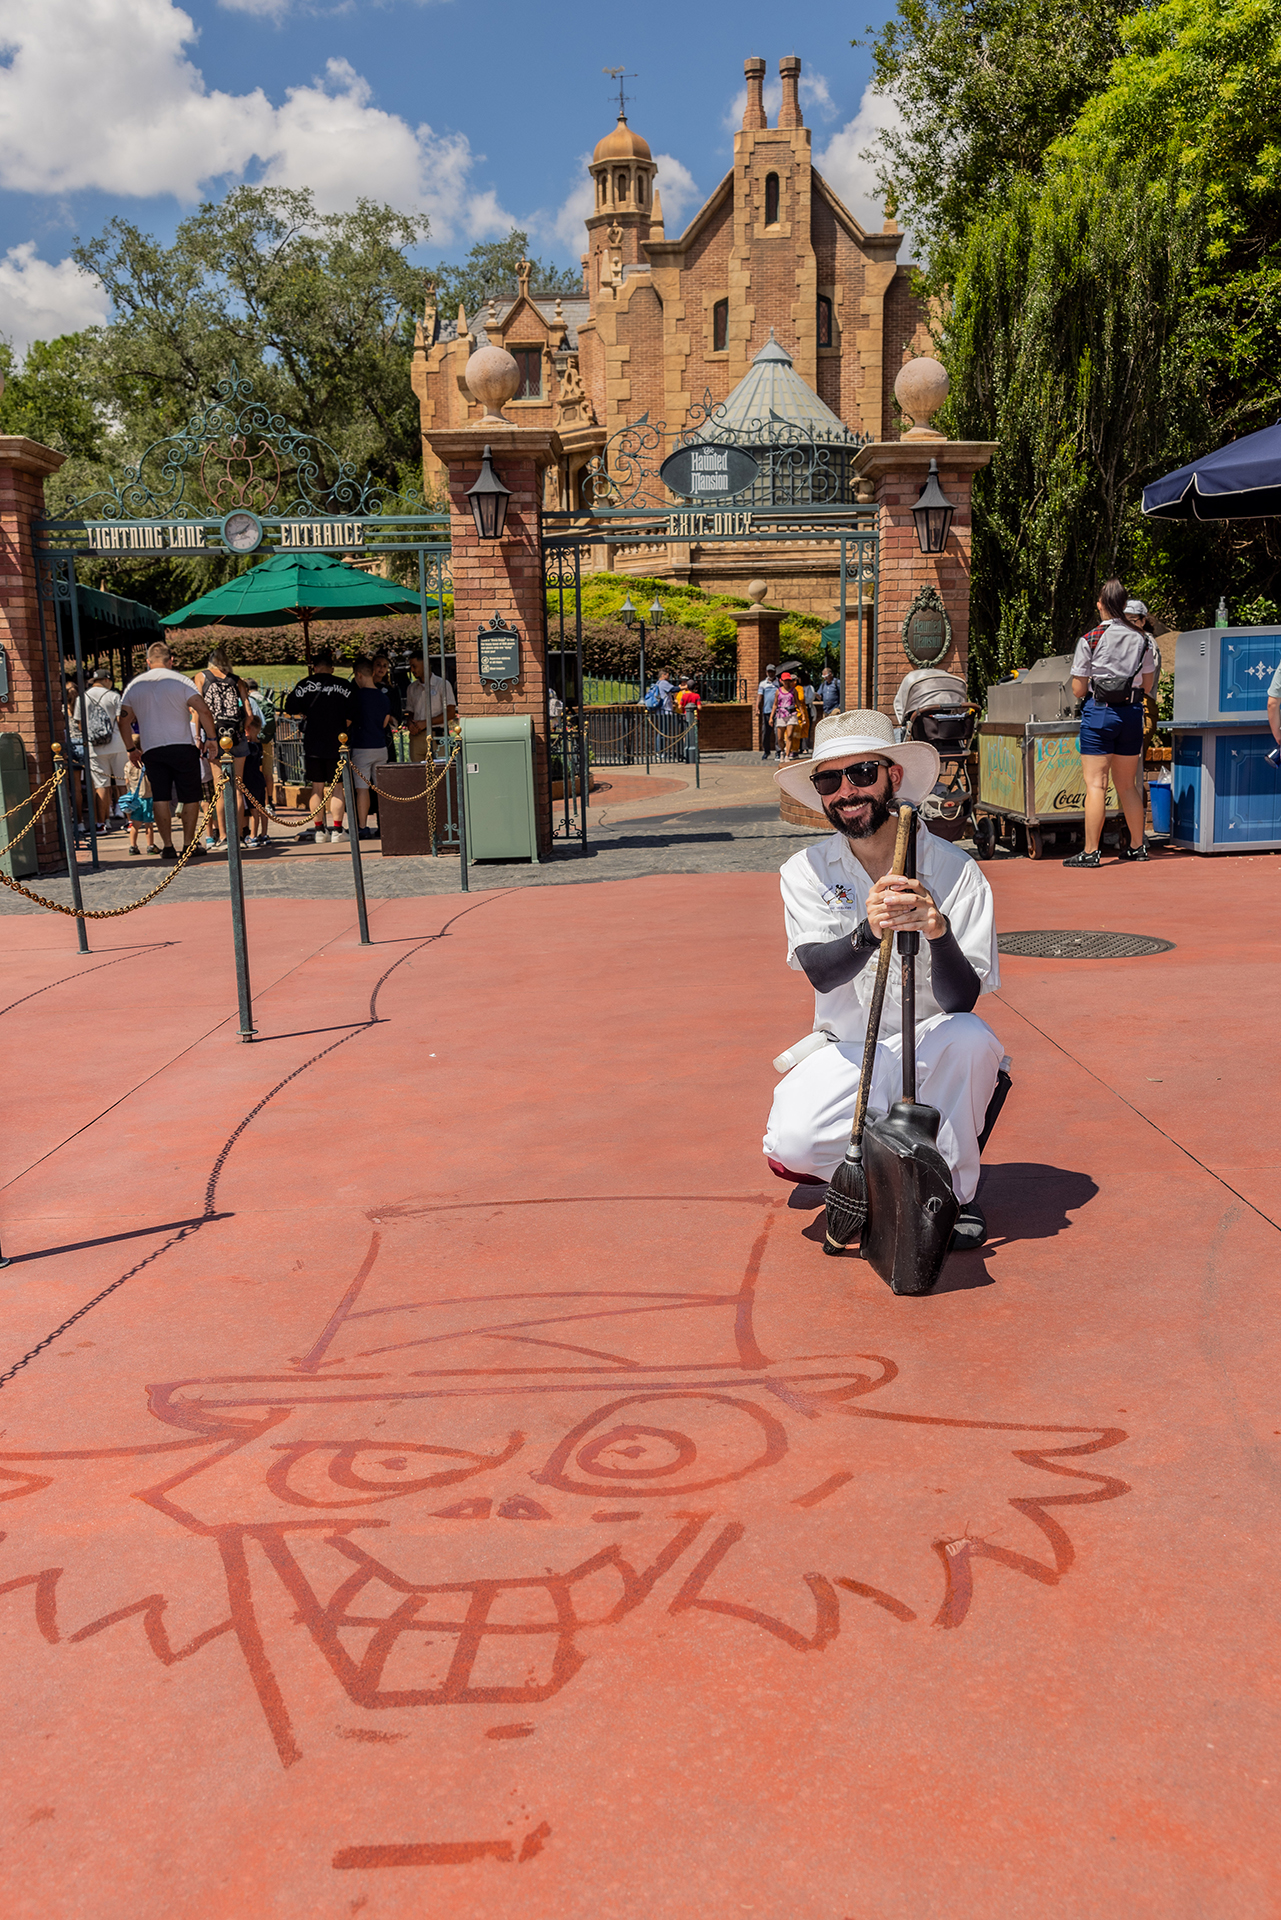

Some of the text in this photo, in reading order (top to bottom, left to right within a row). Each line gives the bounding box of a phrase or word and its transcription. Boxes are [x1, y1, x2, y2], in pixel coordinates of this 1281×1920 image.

[691, 450, 729, 471] Haunted
[690, 472, 729, 494] Mansion
[280, 522, 364, 547] ENTRANCE
[669, 512, 753, 537] EXIT ONLY
[87, 527, 164, 549] LIGHTNING
[168, 526, 206, 548] LANE
[913, 618, 942, 633] Haunted
[913, 634, 943, 651] Mansion
[1036, 737, 1073, 764] ICE
